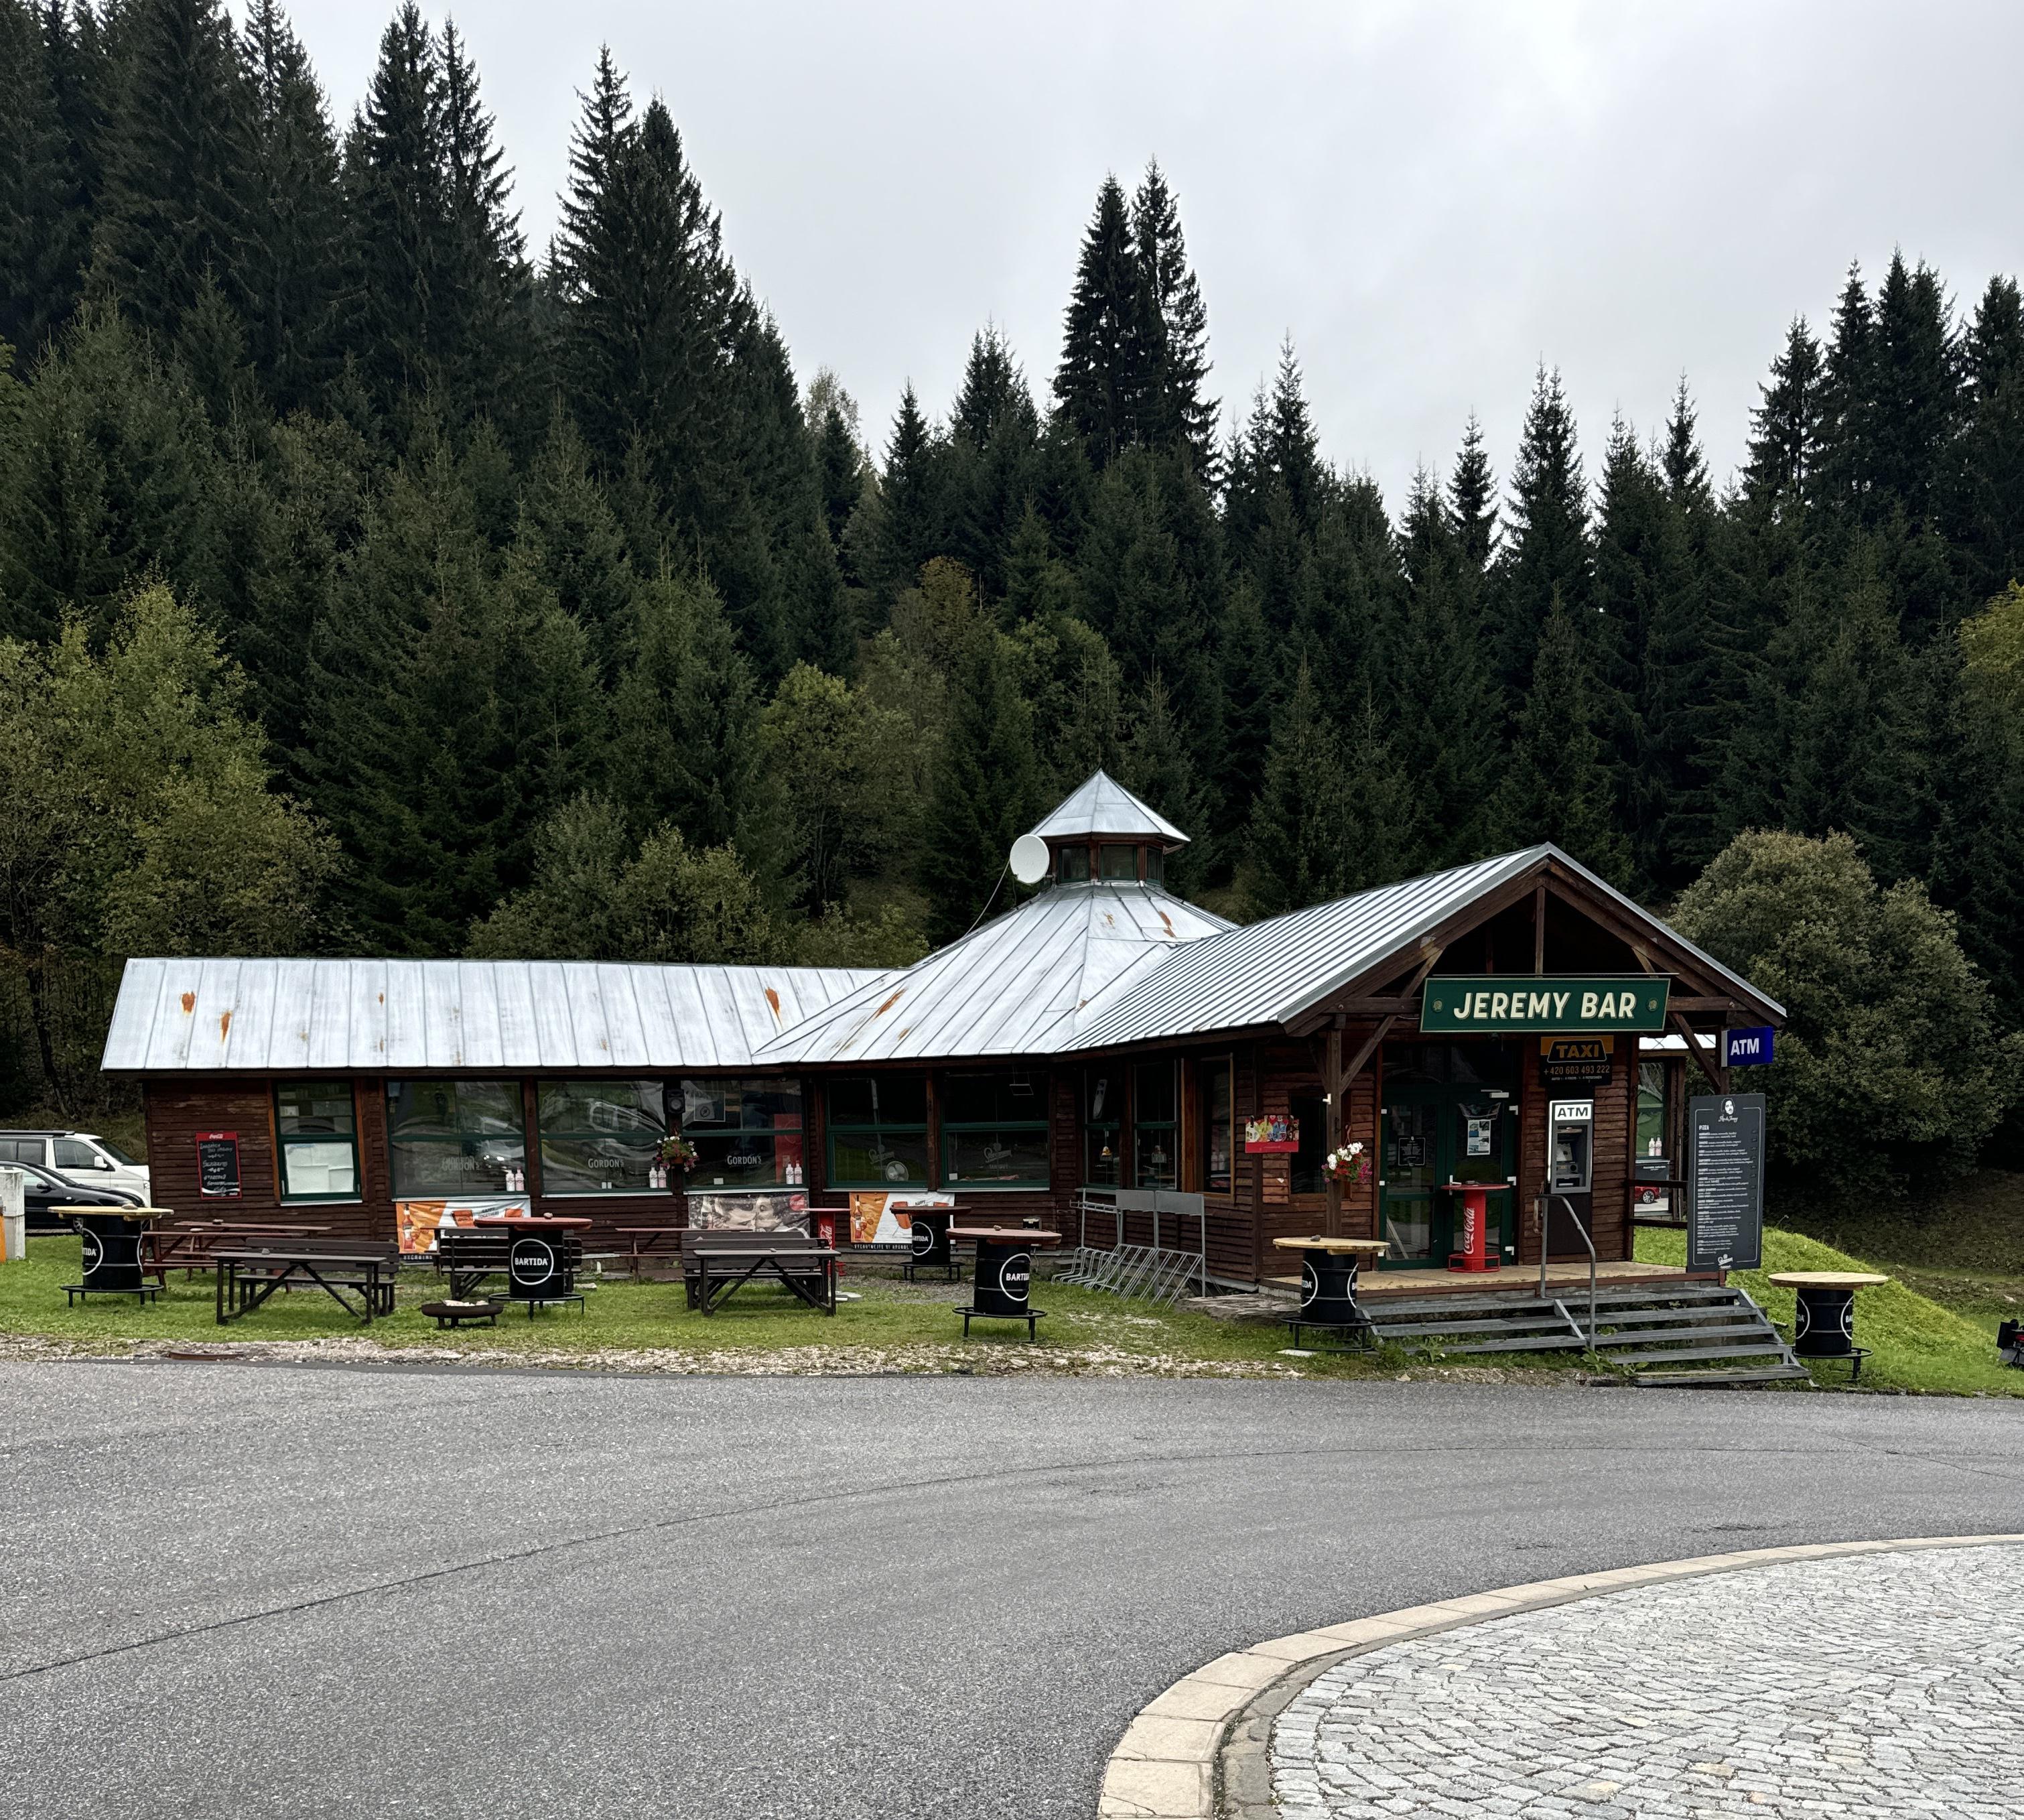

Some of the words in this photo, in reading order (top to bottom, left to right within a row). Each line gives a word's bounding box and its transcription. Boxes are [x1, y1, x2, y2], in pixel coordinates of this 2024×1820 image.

[1453, 992, 1571, 1019] JEREMY
[1580, 992, 1637, 1019] BAR
[1556, 1044, 1599, 1058] TAXI
[1730, 1038, 1759, 1056] ATM
[1565, 1066, 1579, 1074] 603
[1581, 1065, 1595, 1074] 493
[1597, 1065, 1610, 1074] 222
[1557, 1106, 1589, 1117] ATM
[727, 1155, 762, 1165] GORDON'S
[515, 1257, 548, 1266] BARTIDA
[1006, 1273, 1030, 1281] BARTI
